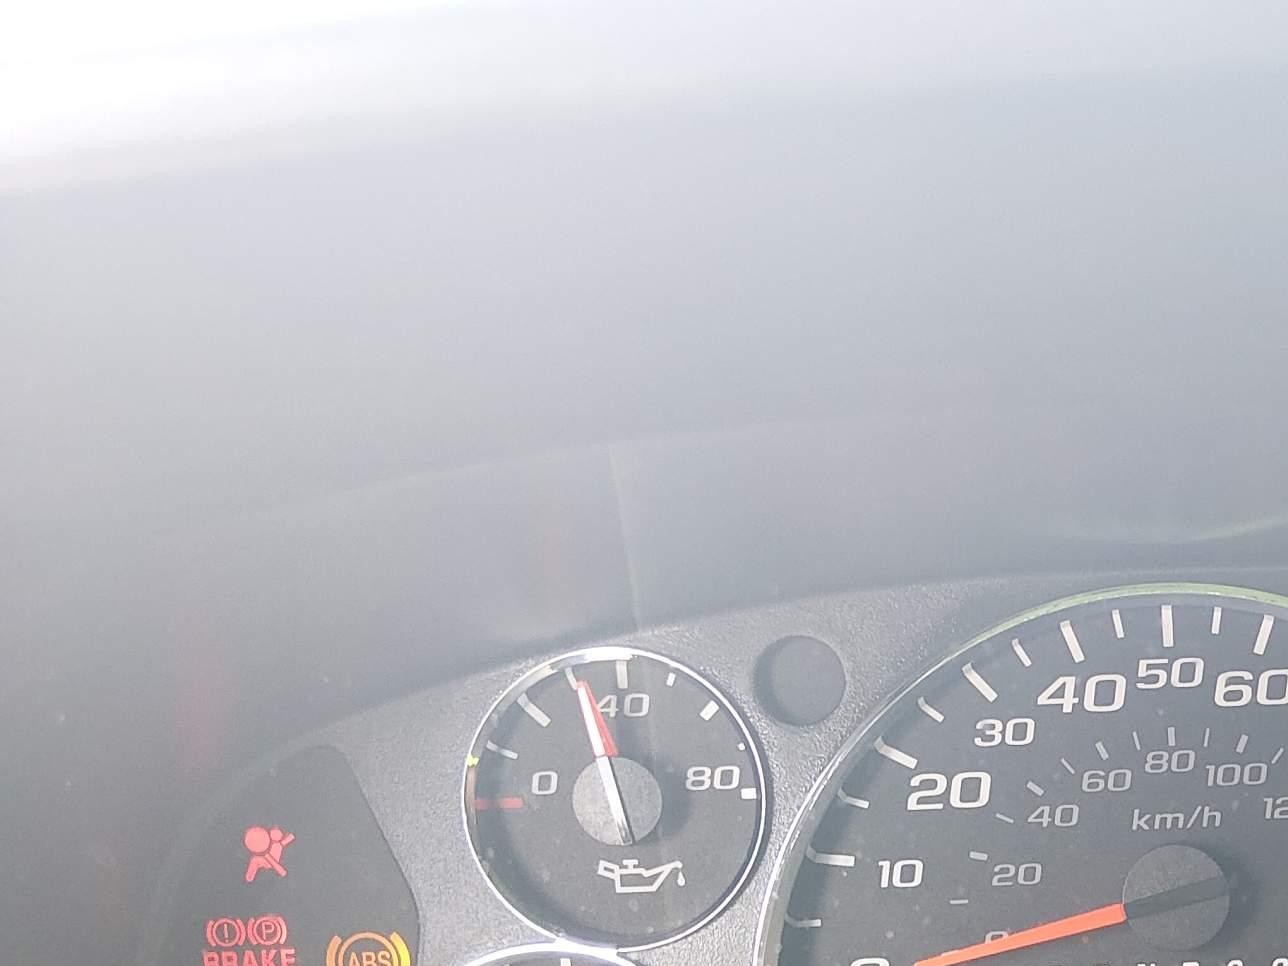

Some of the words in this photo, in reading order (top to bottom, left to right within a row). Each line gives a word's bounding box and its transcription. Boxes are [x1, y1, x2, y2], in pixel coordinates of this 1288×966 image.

[1136, 658, 1205, 688] 50
[1037, 674, 1126, 712] 40
[596, 693, 649, 718] 40
[974, 718, 1035, 746] 30
[1144, 750, 1195, 772] 80
[532, 771, 557, 794] 0
[685, 766, 740, 790] 80
[1081, 769, 1132, 792] 60
[1206, 763, 1267, 786] 100
[906, 771, 991, 810] 20
[1028, 804, 1080, 827] 40
[1132, 806, 1222, 830] km/h
[878, 859, 923, 887] 10
[991, 864, 1042, 886] 20
